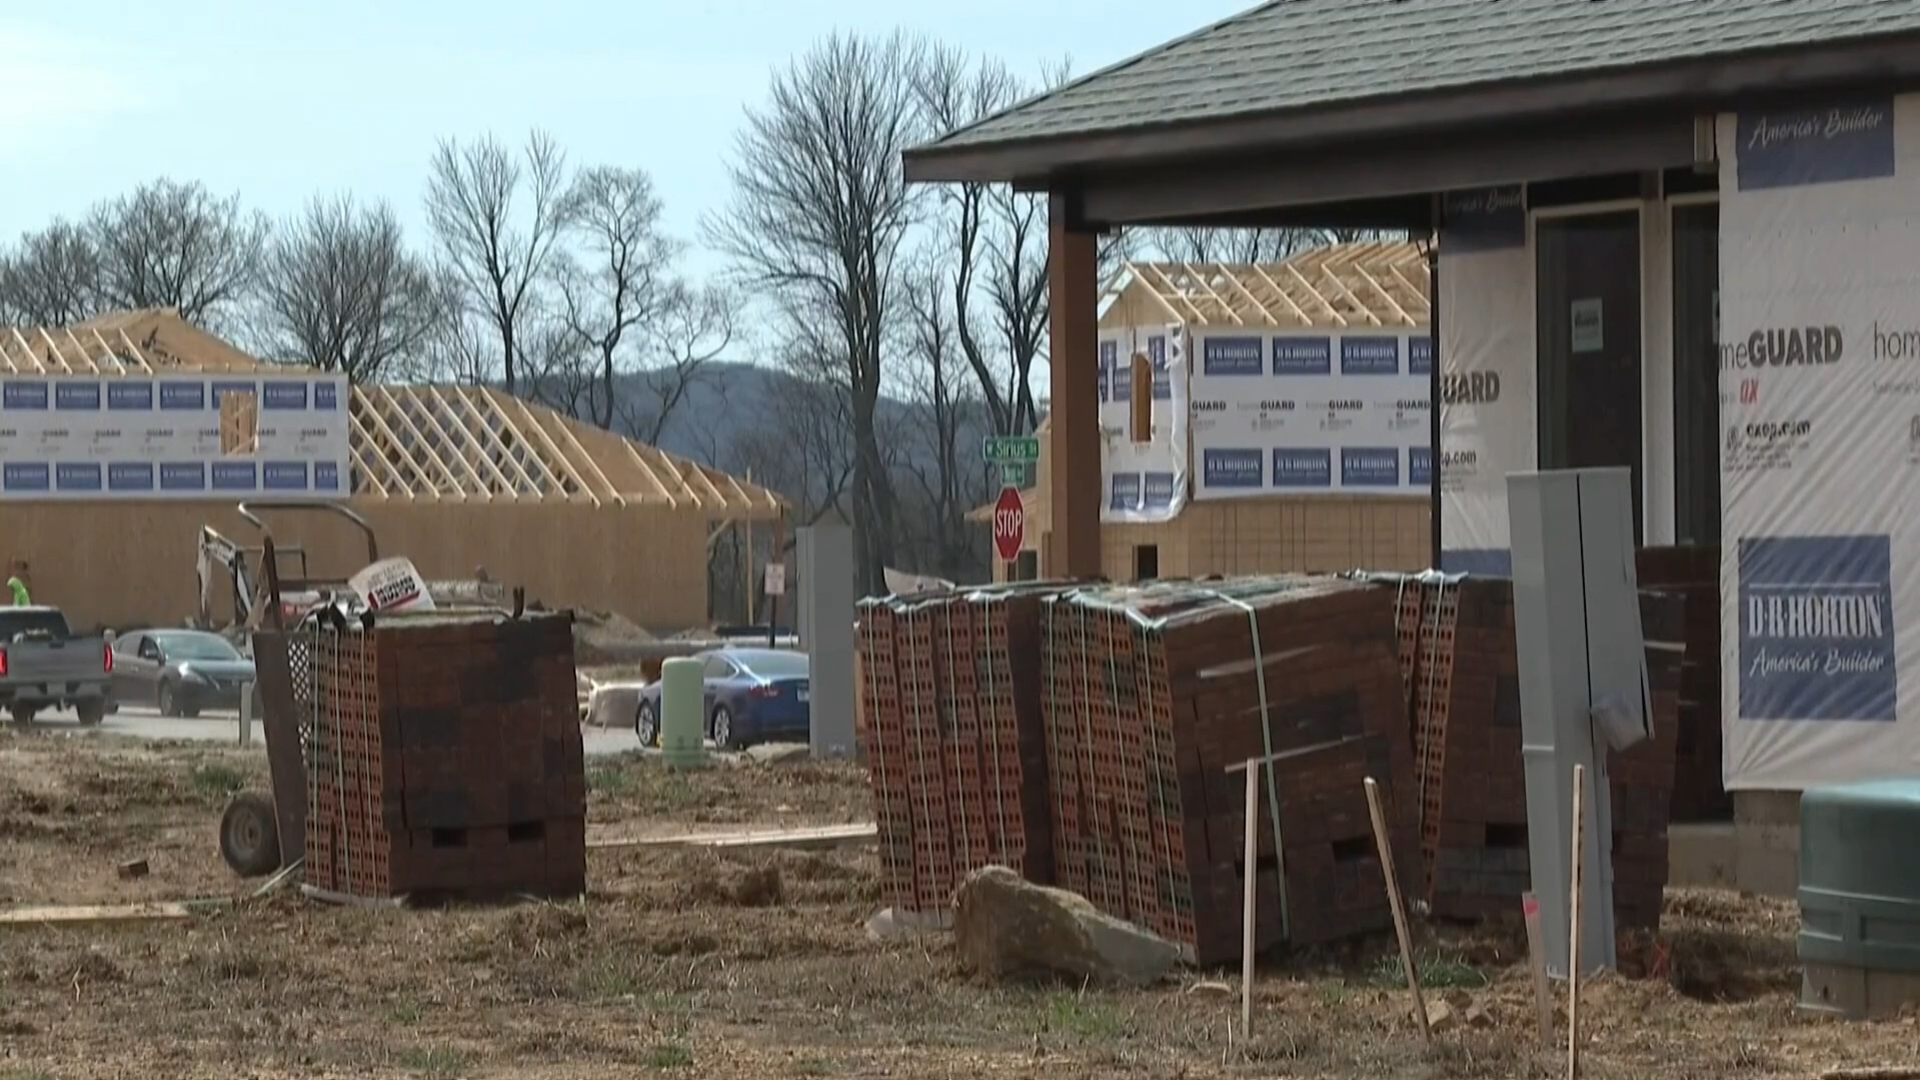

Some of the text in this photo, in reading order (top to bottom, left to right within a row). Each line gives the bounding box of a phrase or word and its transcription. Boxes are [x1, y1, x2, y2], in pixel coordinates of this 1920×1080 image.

[1748, 106, 1884, 150] America's Builder
[1440, 370, 1500, 405] UARD
[996, 509, 1022, 538] STOP
[1749, 646, 1884, 678] America's Builder
